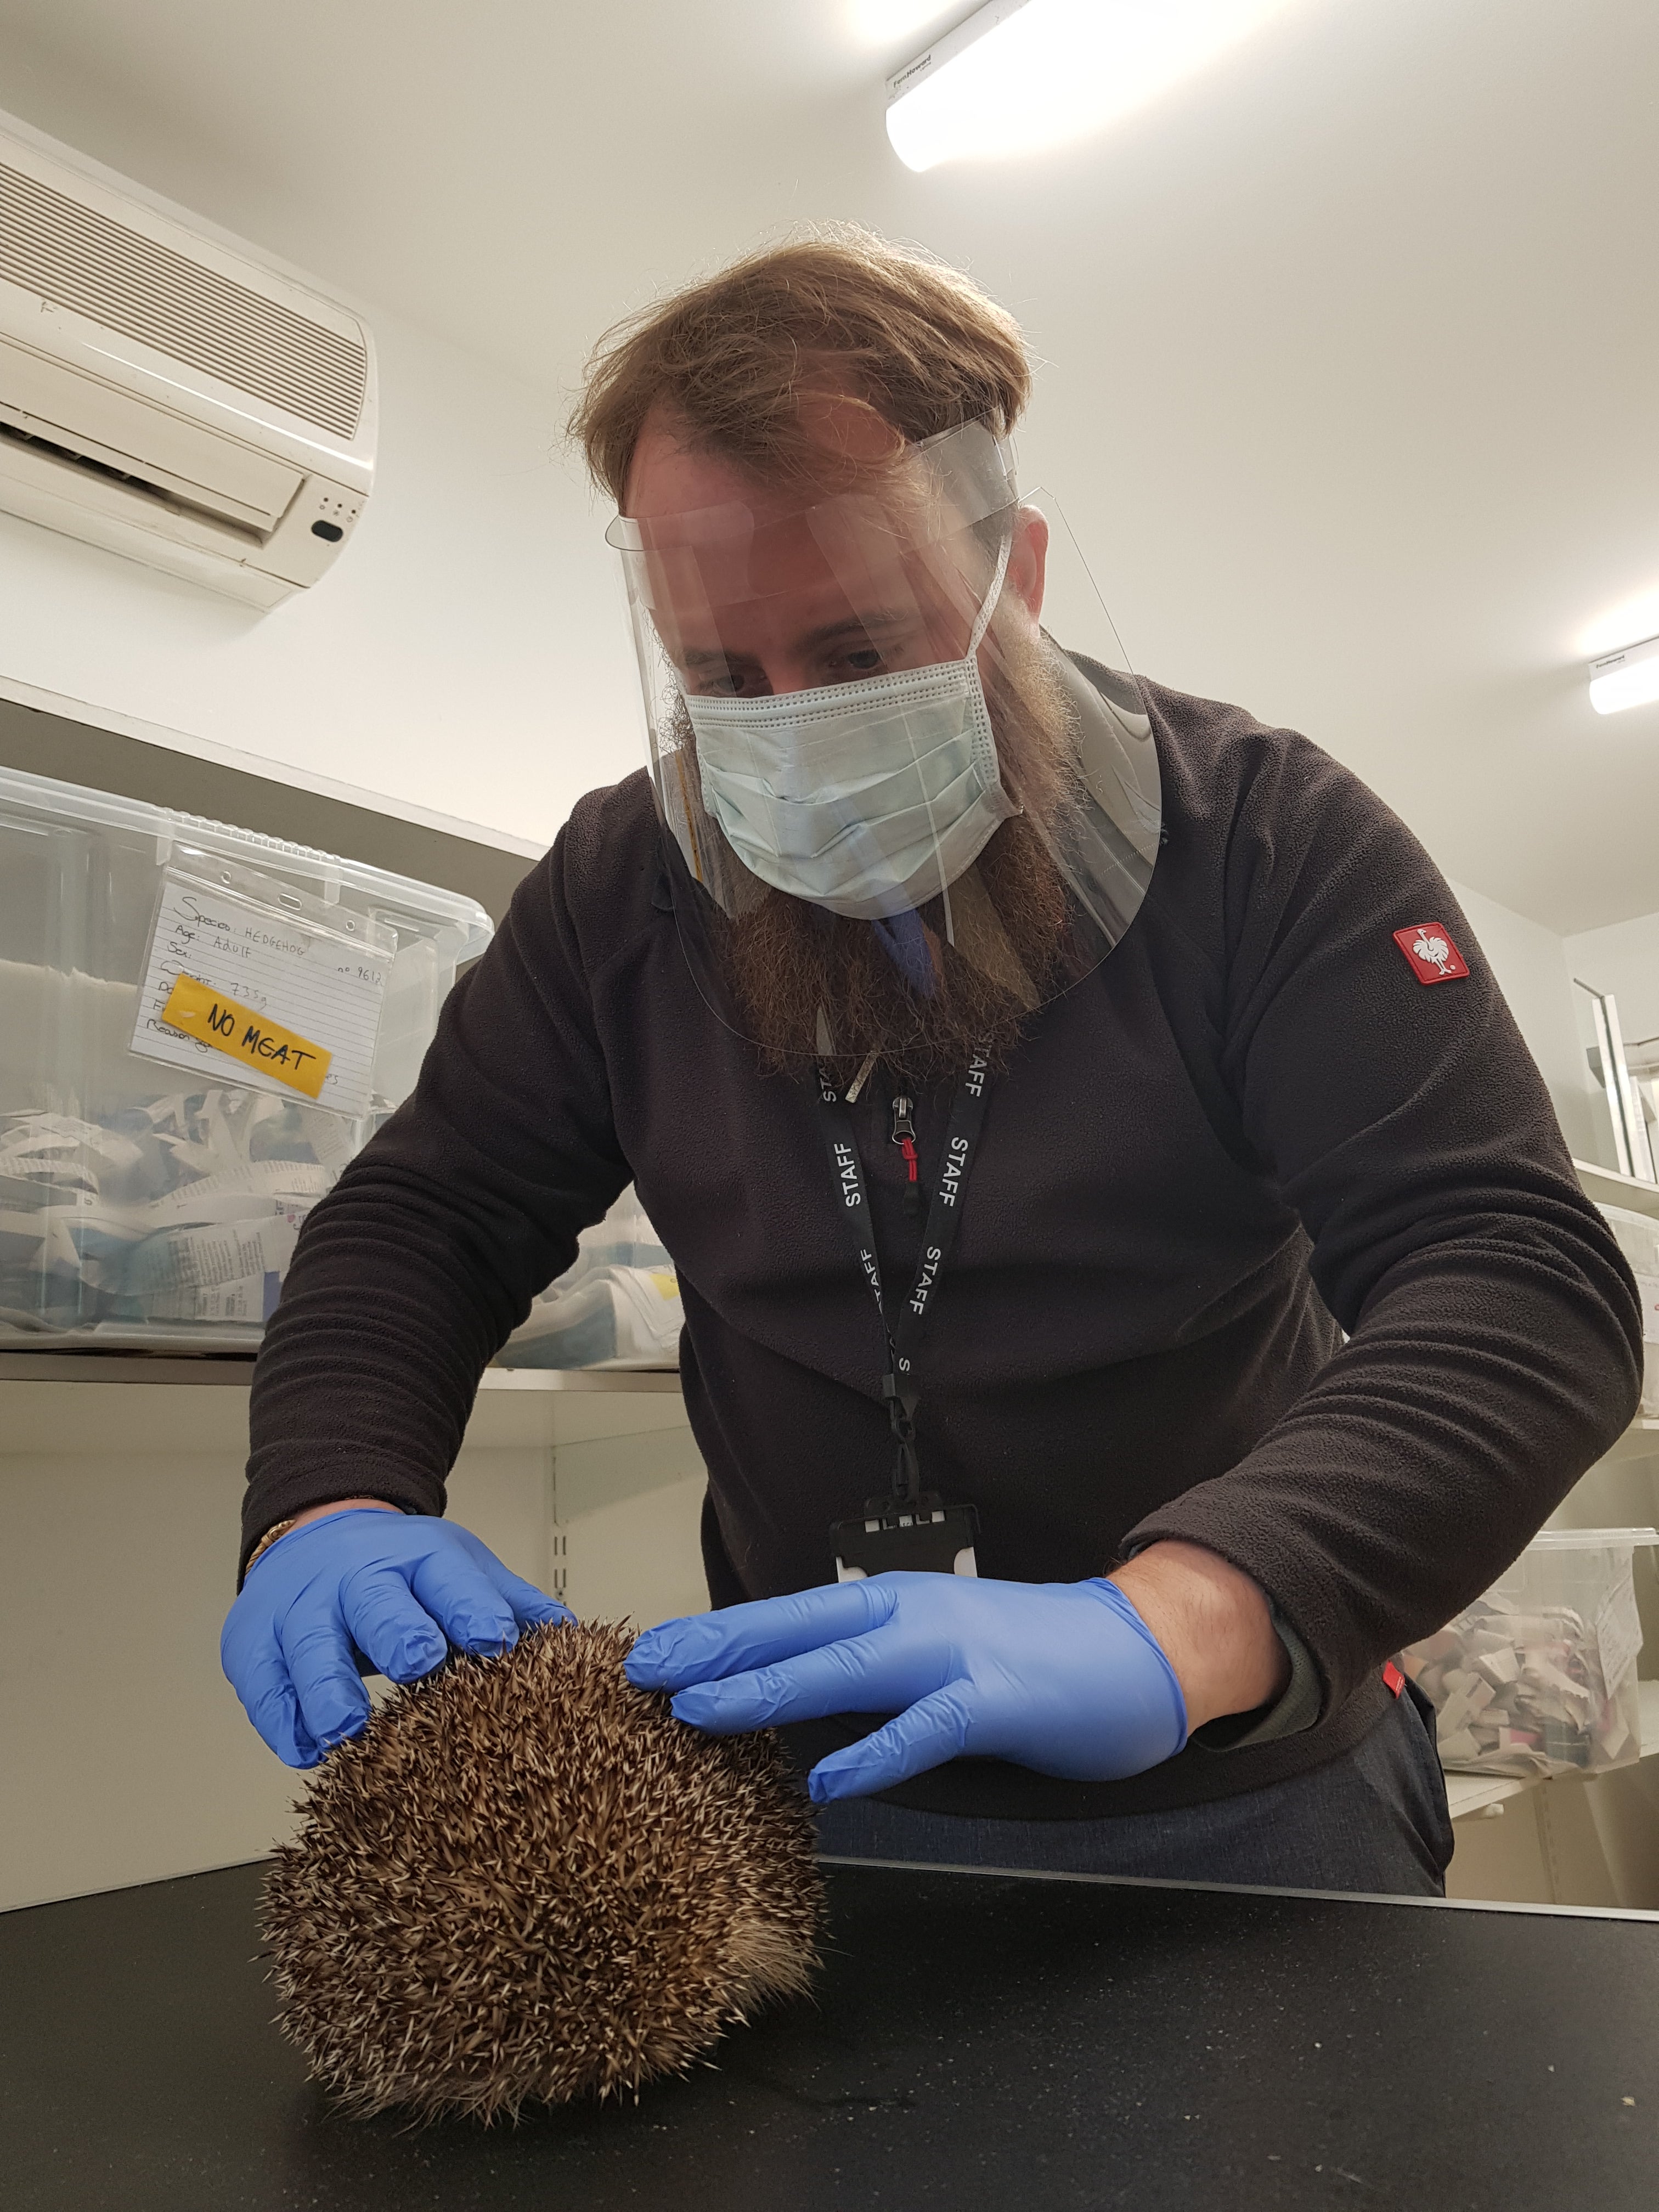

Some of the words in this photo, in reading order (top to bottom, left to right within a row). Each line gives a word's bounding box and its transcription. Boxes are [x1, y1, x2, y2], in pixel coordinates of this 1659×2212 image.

[167, 941, 192, 958] Sex:
[175, 925, 200, 944] Age:
[245, 927, 305, 956] HEDGEHOG
[146, 1019, 190, 1040] Reason
[207, 1003, 235, 1036] NO
[241, 1025, 317, 1070] MEAT
[833, 1143, 861, 1207] STAFF
[939, 1137, 968, 1206] STAFF
[909, 1246, 941, 1315] STAFF
